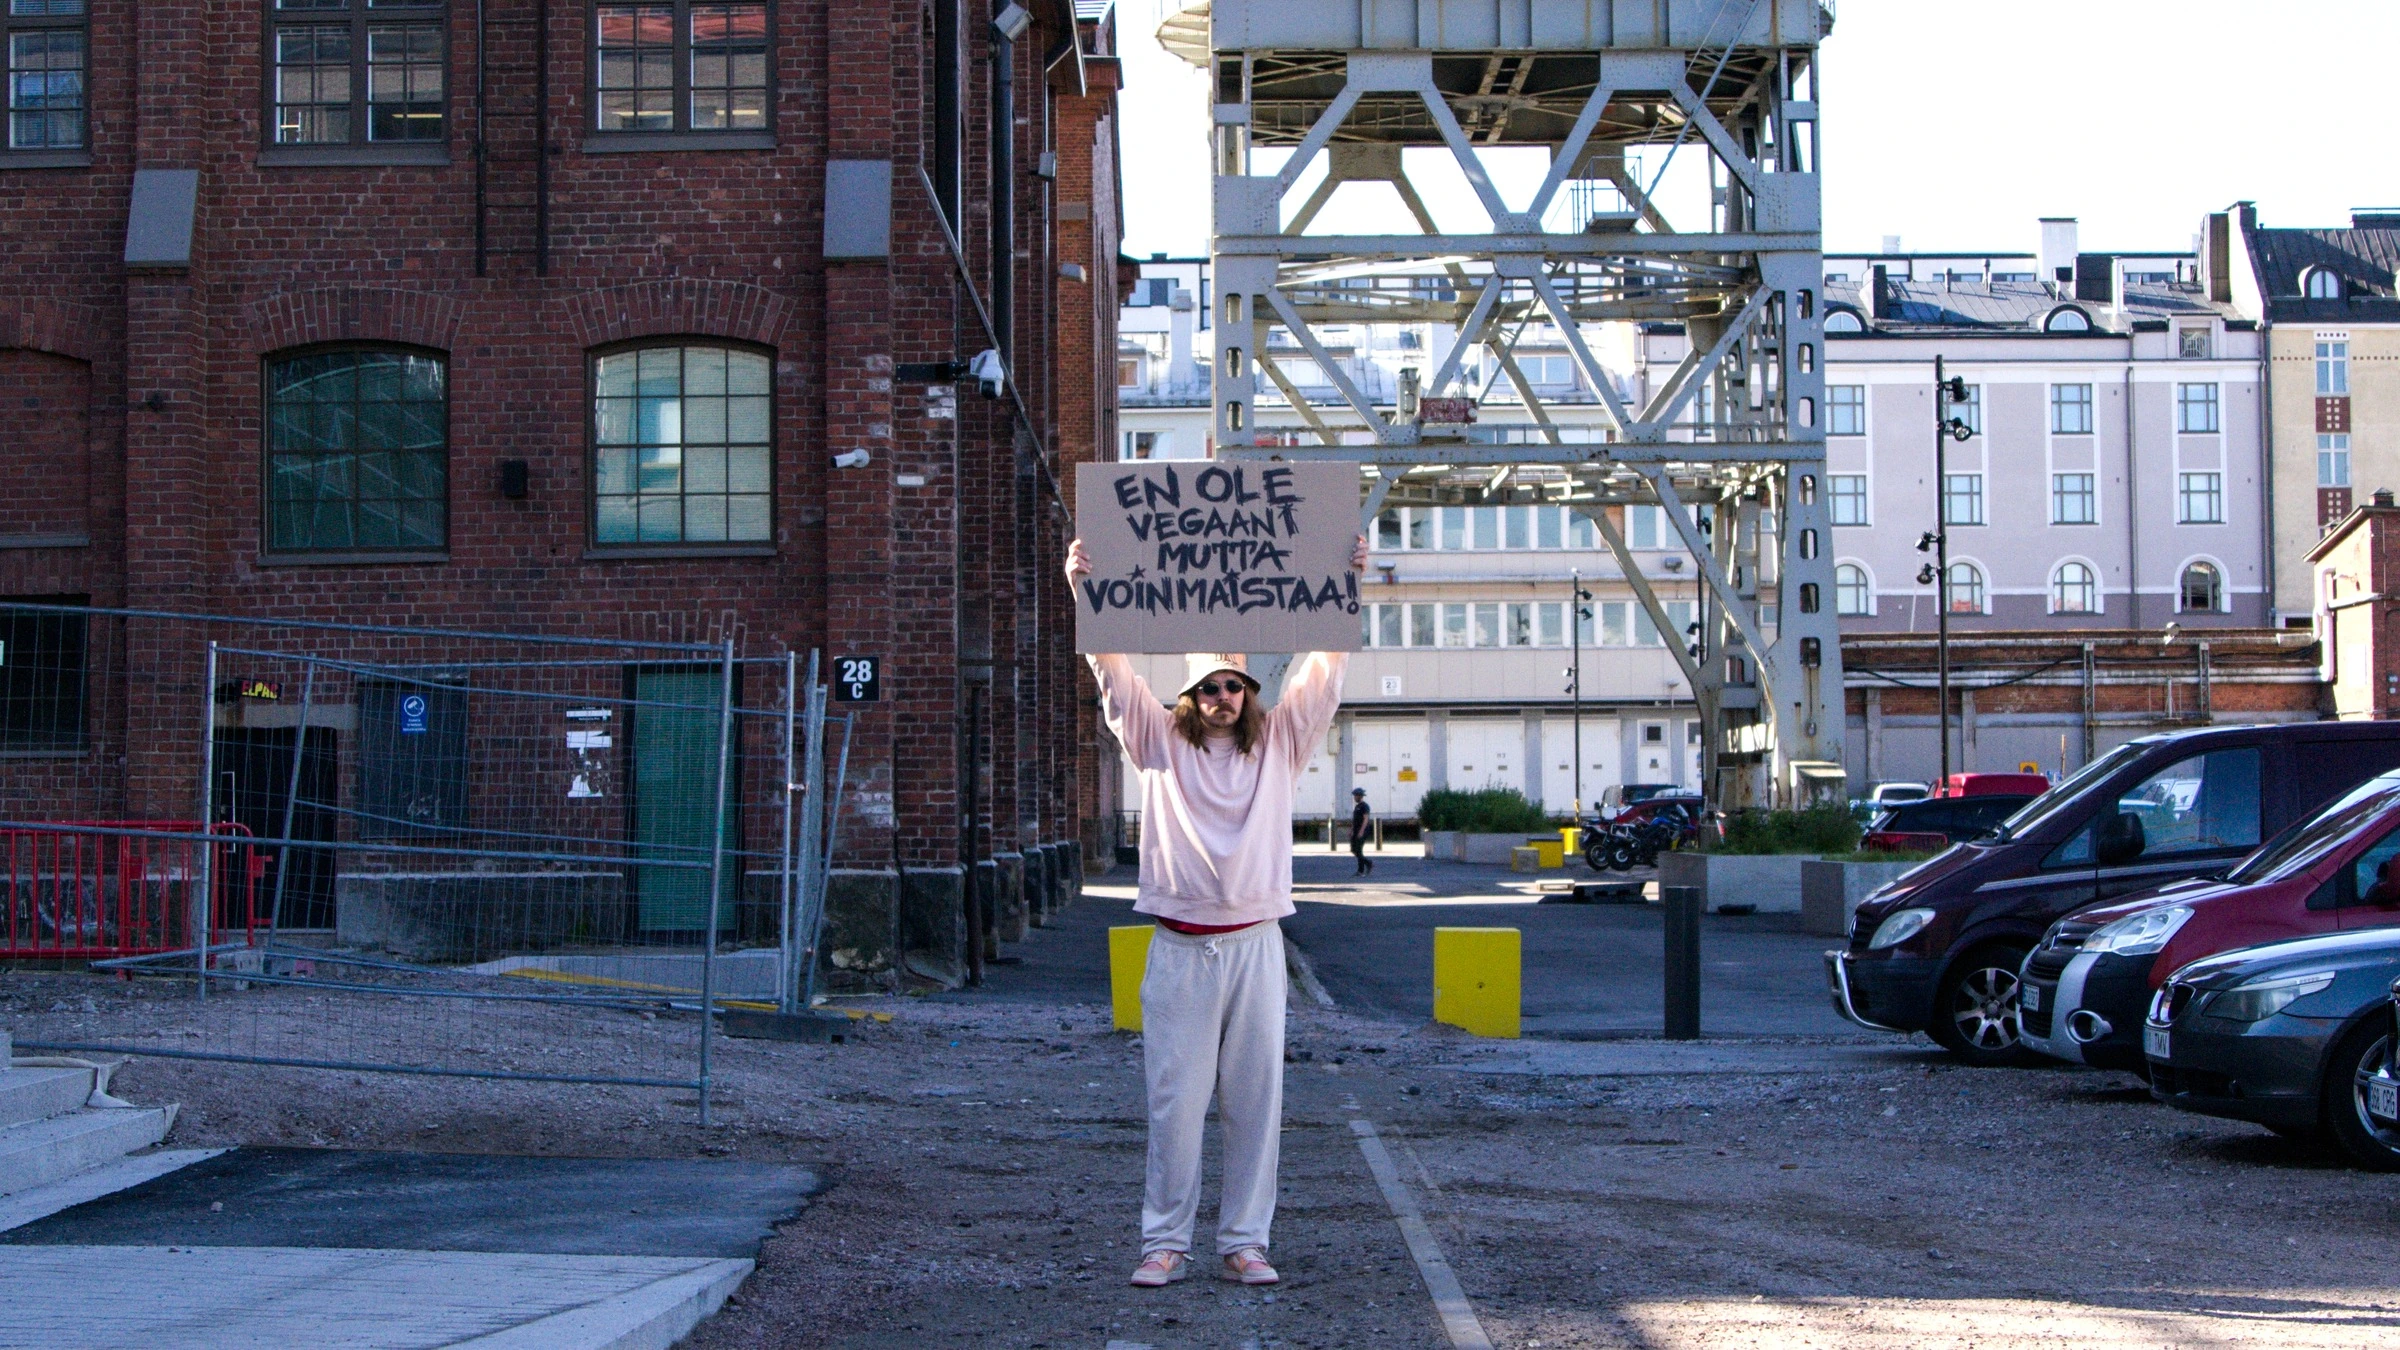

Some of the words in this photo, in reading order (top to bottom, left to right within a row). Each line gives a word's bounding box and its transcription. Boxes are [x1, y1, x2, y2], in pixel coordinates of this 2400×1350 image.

[1114, 464, 1180, 512] EN
[1196, 465, 1305, 506] OLE
[1157, 540, 1292, 573] MUTTA
[842, 660, 872, 682] 28
[852, 682, 863, 699] C
